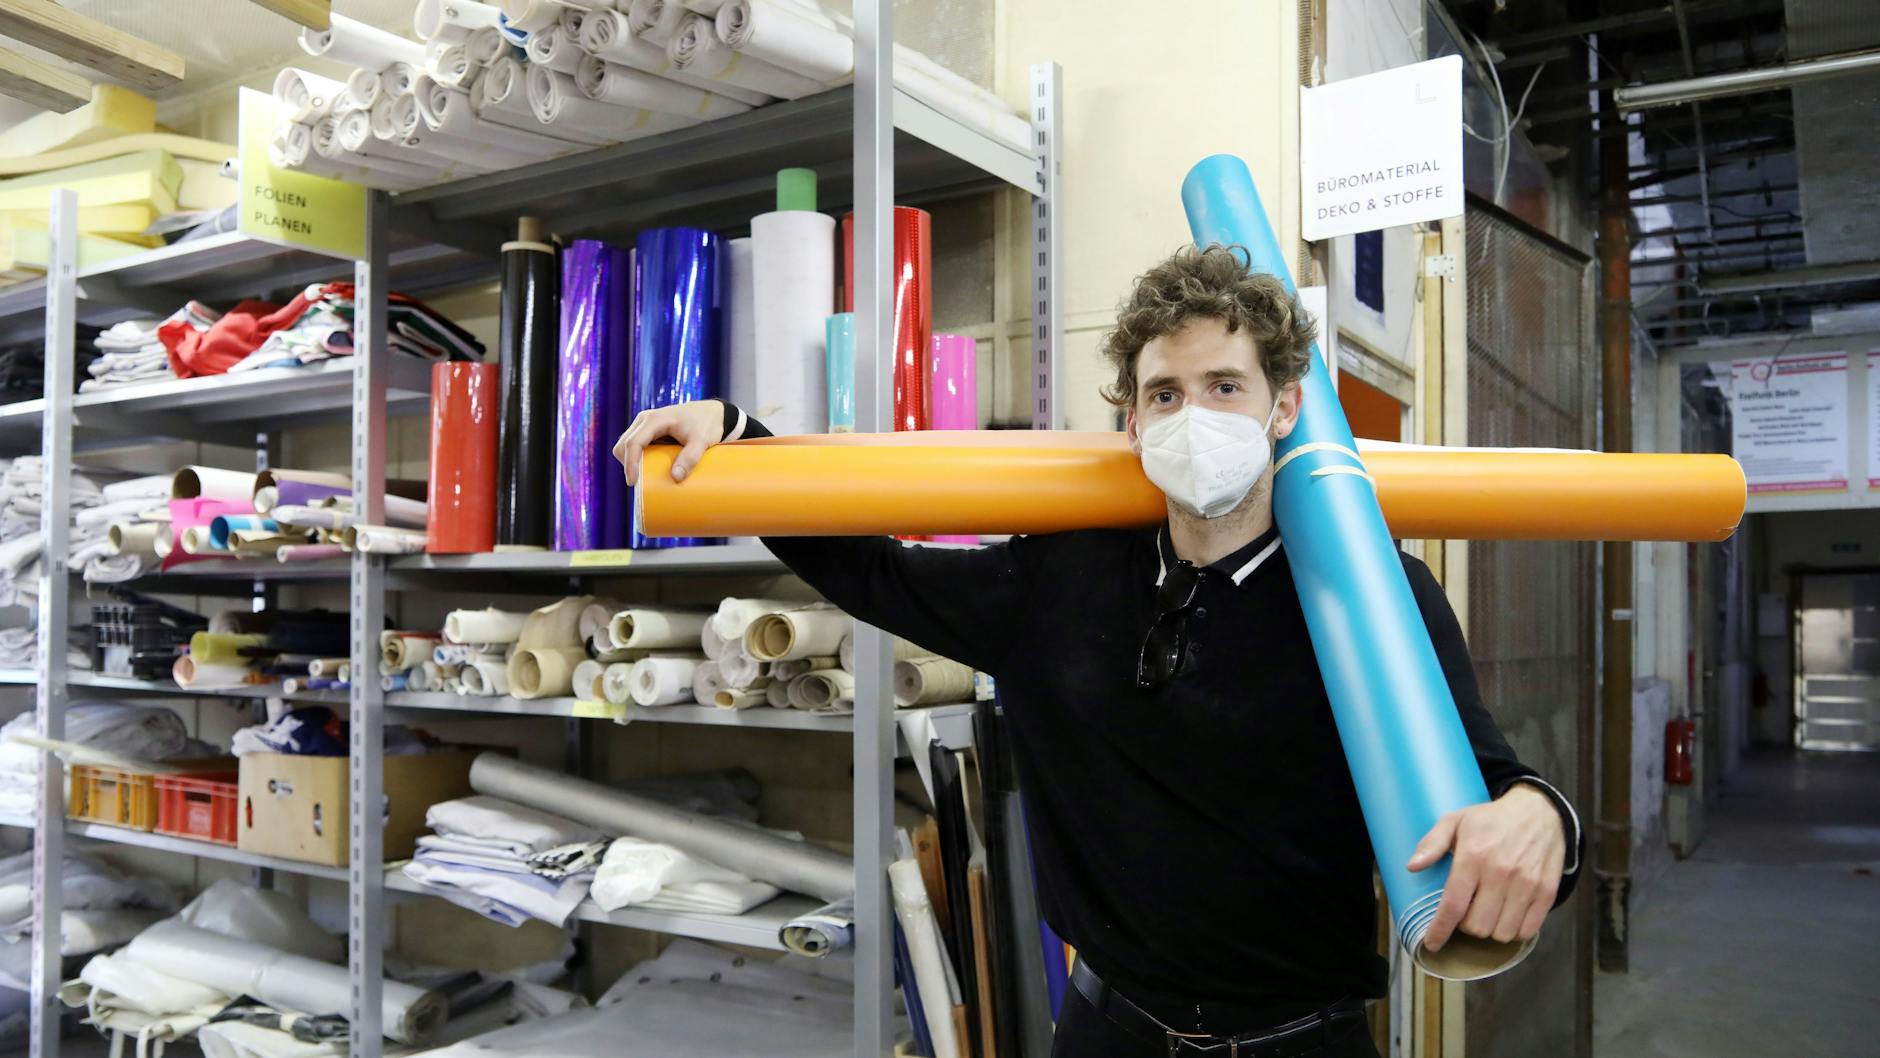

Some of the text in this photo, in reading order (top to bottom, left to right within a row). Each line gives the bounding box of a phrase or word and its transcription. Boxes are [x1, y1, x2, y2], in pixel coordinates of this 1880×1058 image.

[1317, 160, 1441, 194] BÜROMATERIAL
[255, 185, 306, 208] FOLIEN
[1317, 185, 1444, 220] DEKO & STOFFE
[255, 211, 312, 235] PLANEN
